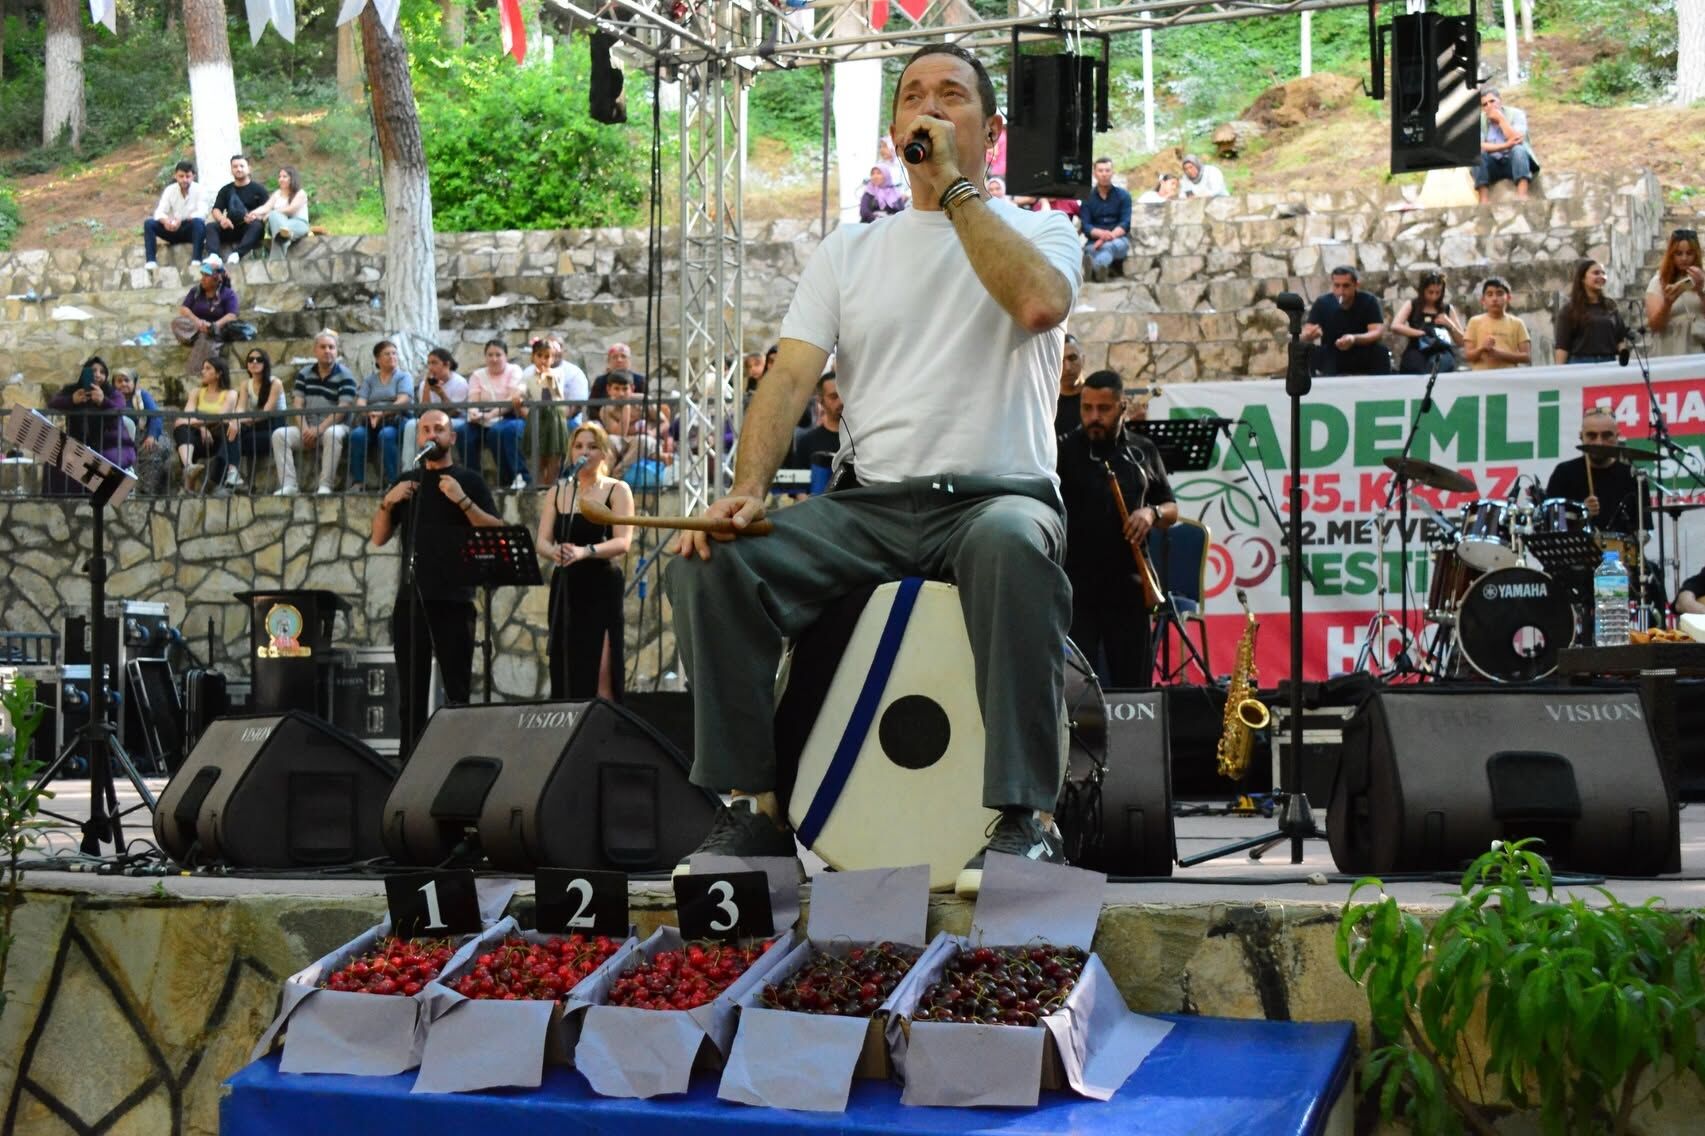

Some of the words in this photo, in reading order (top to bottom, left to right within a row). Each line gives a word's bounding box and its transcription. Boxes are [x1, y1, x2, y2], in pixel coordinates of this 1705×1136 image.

[1498, 583, 1548, 598] YAMAHA
[518, 711, 580, 729] VISION
[1104, 702, 1156, 721] ION
[1544, 703, 1642, 721] VISION
[417, 879, 449, 930] 1
[565, 877, 597, 929] 2
[707, 879, 740, 932] 3
